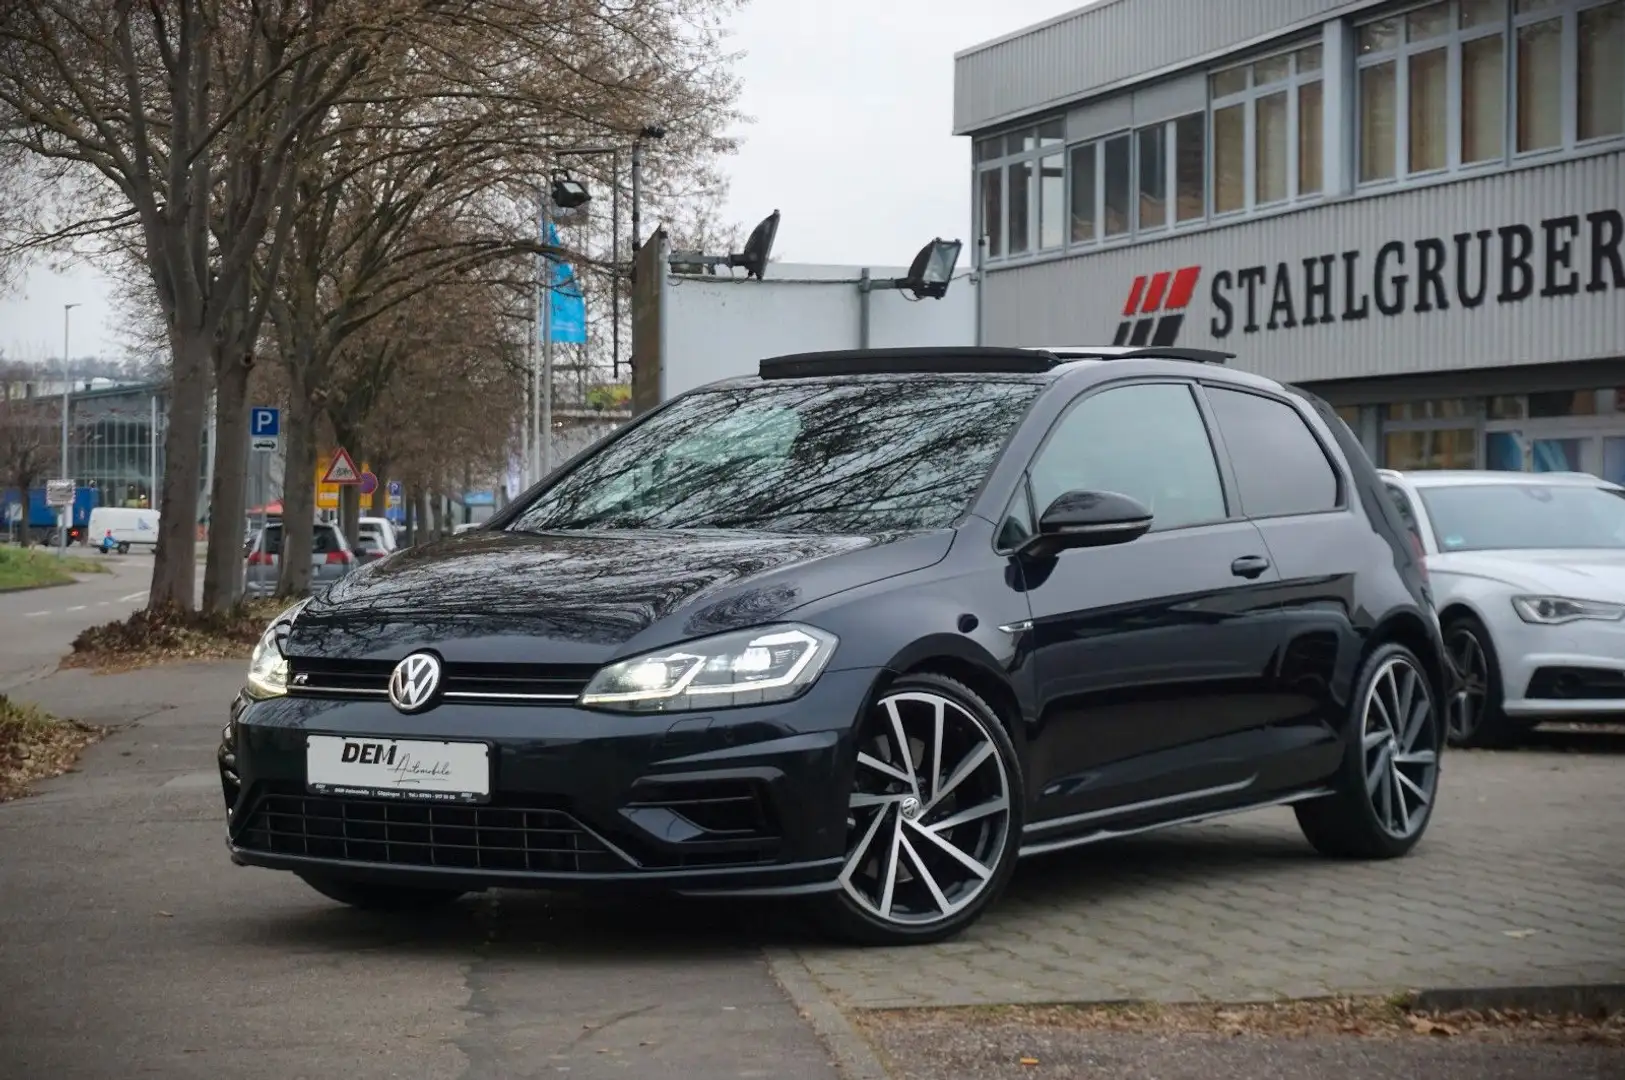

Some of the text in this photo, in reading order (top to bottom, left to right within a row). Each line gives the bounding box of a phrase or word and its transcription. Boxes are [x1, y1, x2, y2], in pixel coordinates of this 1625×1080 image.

[1210, 209, 1625, 338] STAHLGRUBER
[257, 411, 273, 432] P
[341, 742, 398, 765] DEM
